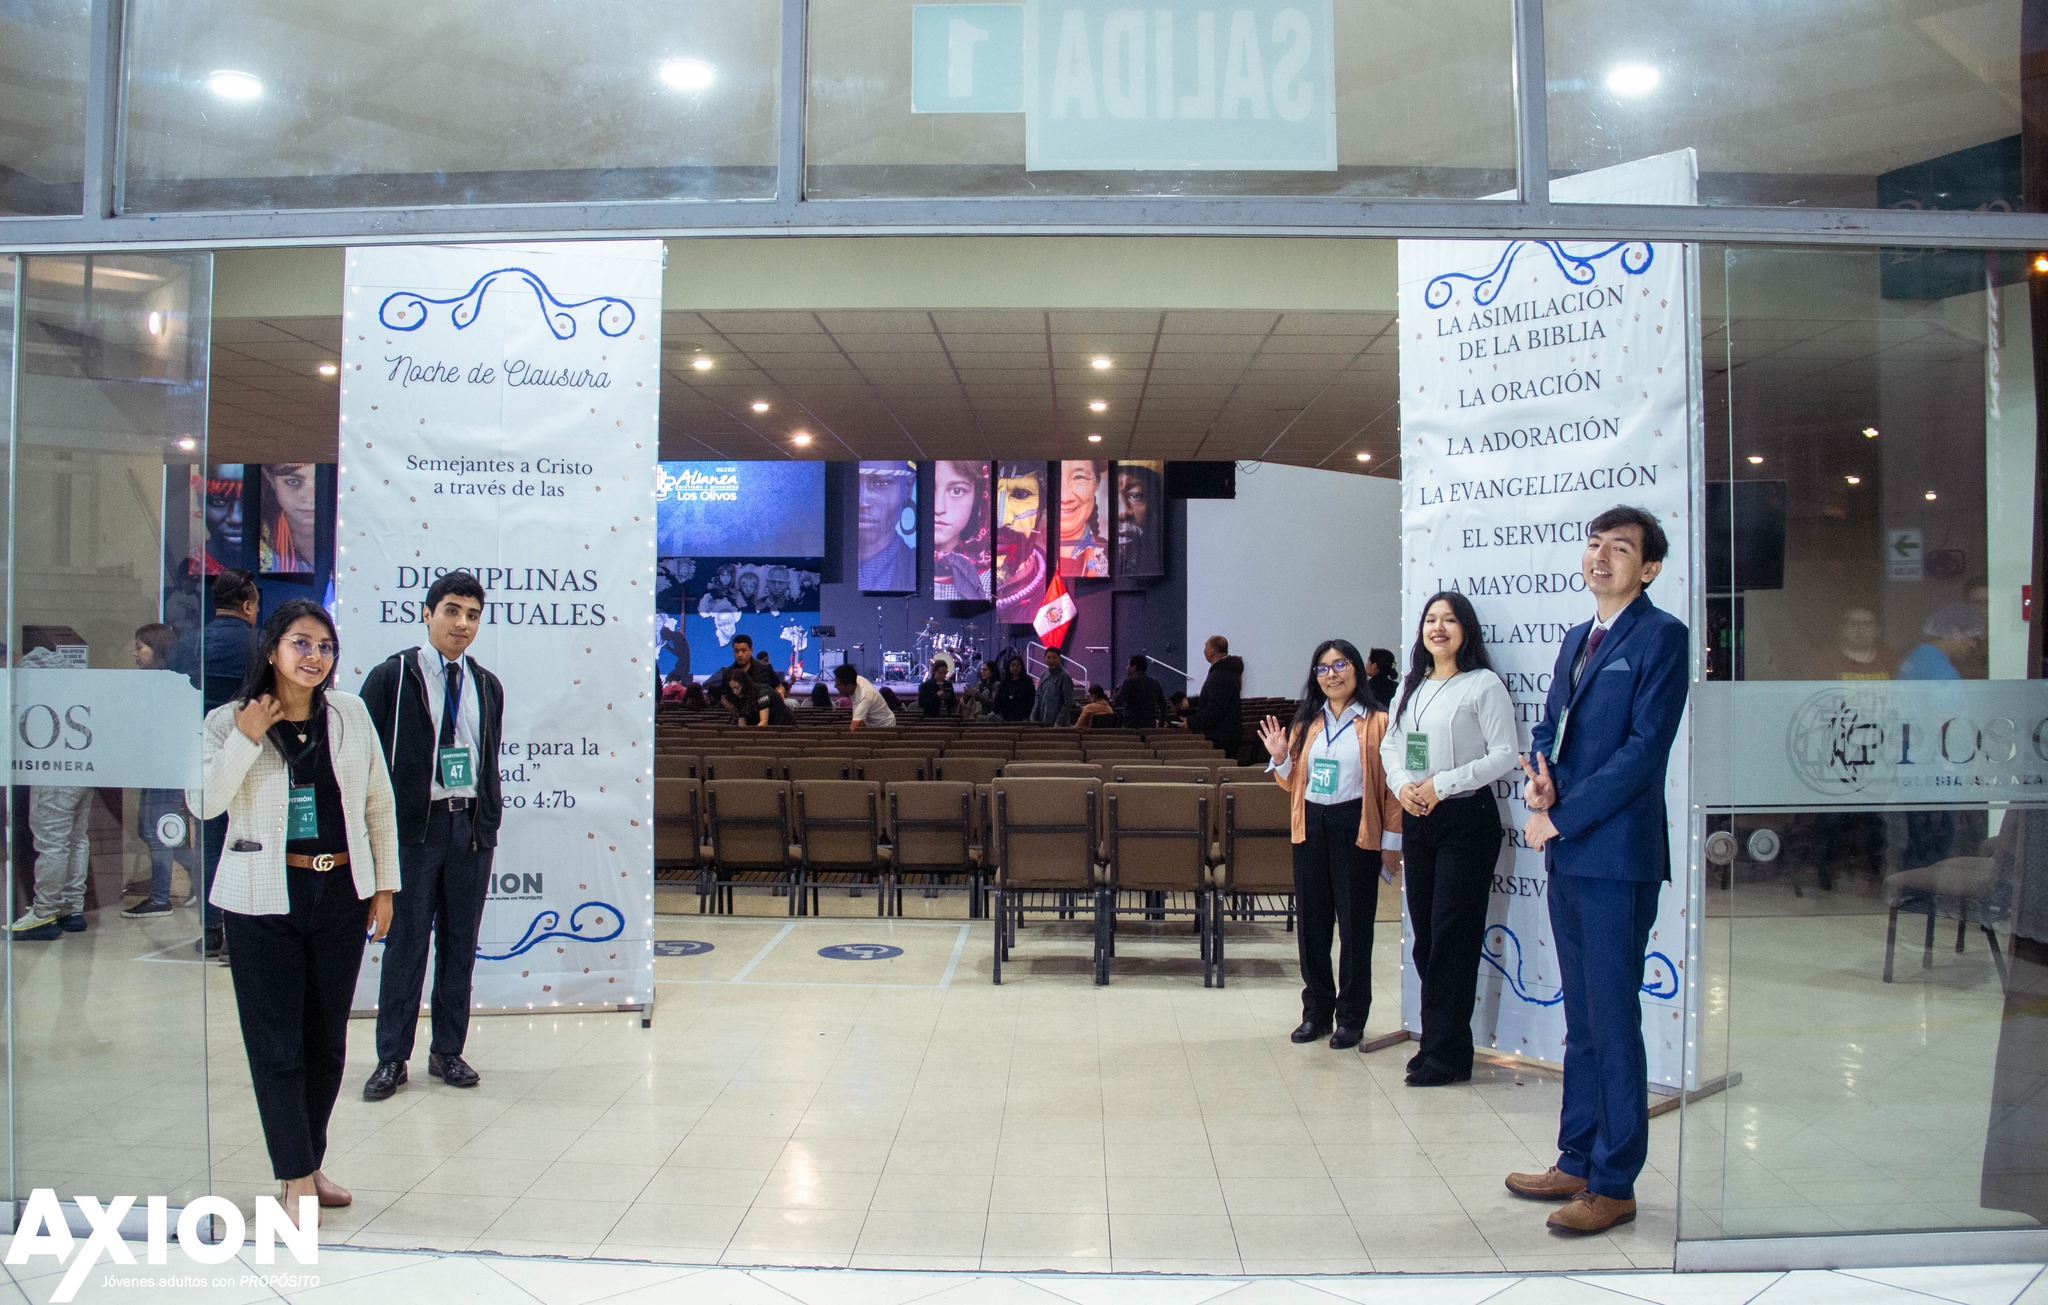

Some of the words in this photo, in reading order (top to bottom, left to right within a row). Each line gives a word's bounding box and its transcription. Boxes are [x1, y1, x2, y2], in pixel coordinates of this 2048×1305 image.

[1436, 317, 1462, 337] LA
[1467, 284, 1625, 331] ASIMILACIÓN
[1458, 340, 1487, 361] DE
[1493, 335, 1521, 355] LA
[1527, 319, 1607, 350] BIBLIA
[385, 355, 461, 388] Noche
[467, 363, 496, 384] de
[504, 359, 611, 388] Clausura
[1459, 387, 1486, 408] LA
[1491, 368, 1602, 404] ORACIÓN
[1446, 437, 1475, 456] LA
[1480, 416, 1620, 453] ADORACIÓN
[406, 455, 515, 476] Semejantes
[520, 461, 530, 474] a
[536, 458, 593, 475] Cristo
[434, 483, 443, 495] a
[449, 480, 506, 496] través
[512, 479, 534, 496] de
[541, 480, 565, 497] las
[1420, 486, 1444, 505] LA
[1450, 463, 1658, 502] EVANGELIZACIÓN
[1462, 529, 1488, 548] EL
[1468, 572, 1592, 595] MAYORDO
[379, 600, 606, 626] ESTUALES
[1508, 623, 1573, 643] AYUN
[12, 704, 93, 750] OS
[500, 741, 520, 756] te
[527, 742, 575, 760] para
[581, 737, 600, 755] la
[451, 764, 464, 779] 47
[500, 763, 541, 782] ad.”
[502, 795, 526, 809] eo
[533, 790, 576, 808] 4:7b
[301, 812, 314, 822] 47
[490, 872, 543, 894] ION
